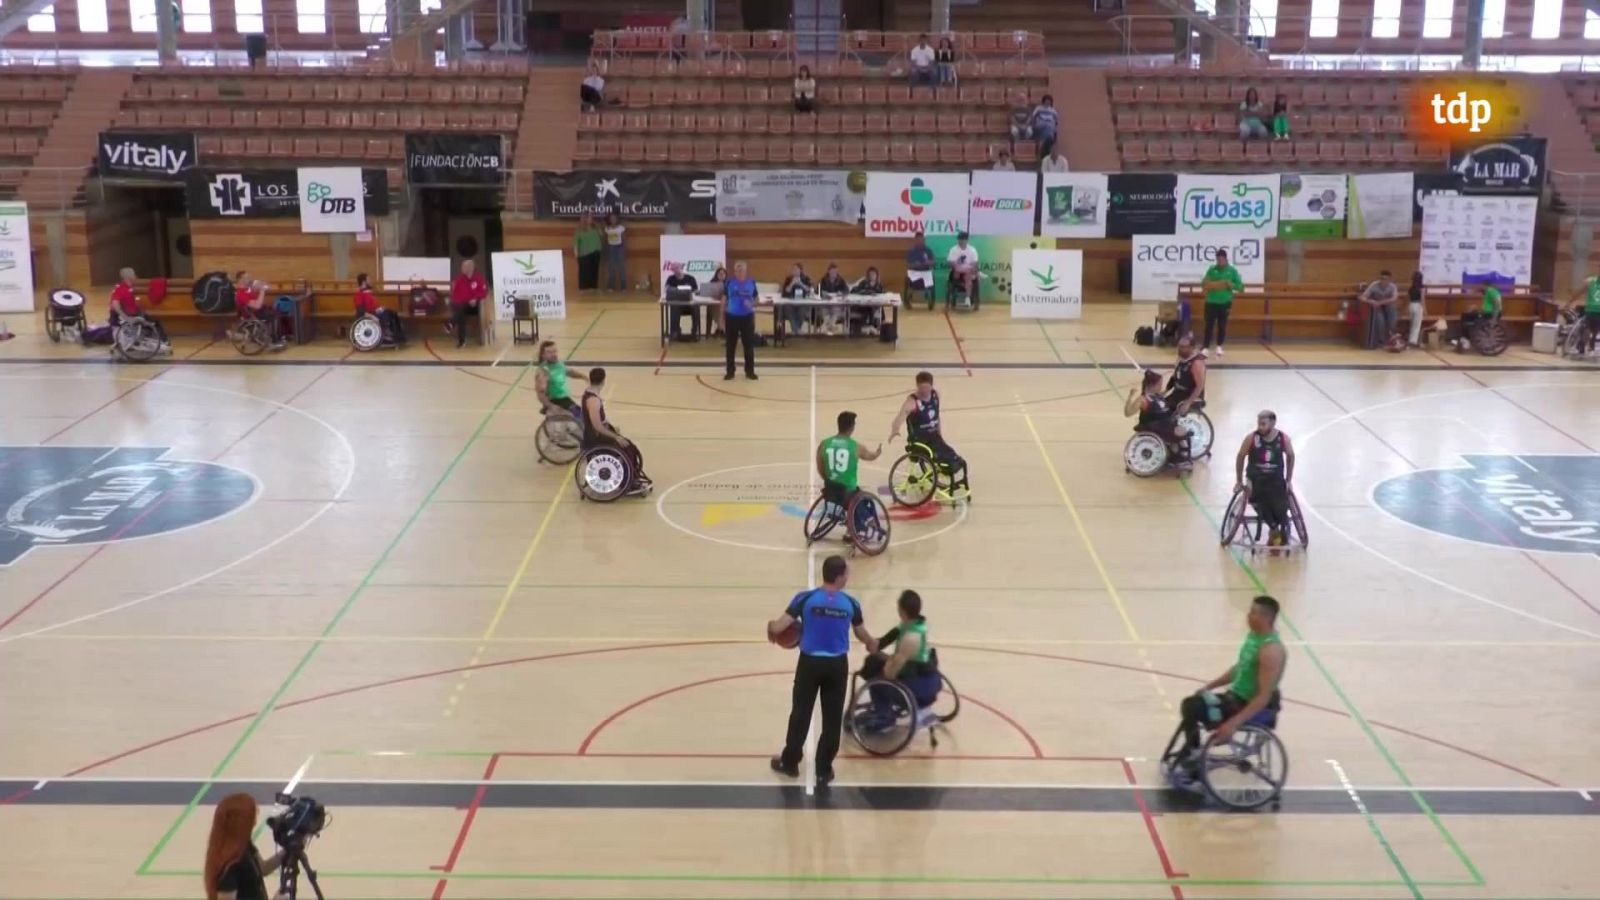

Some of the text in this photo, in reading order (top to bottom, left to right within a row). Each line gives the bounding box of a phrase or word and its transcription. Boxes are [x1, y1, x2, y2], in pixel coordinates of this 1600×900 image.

[104, 142, 187, 174] vitaly
[1474, 162, 1521, 178] LA MAR
[258, 184, 289, 196] LOS
[320, 197, 356, 214] DTB
[551, 200, 613, 214] Fundación
[1190, 195, 1266, 219] Tubasa
[1014, 293, 1079, 305] Extremadura
[826, 448, 849, 473] 19
[1473, 474, 1600, 545] vitaly
